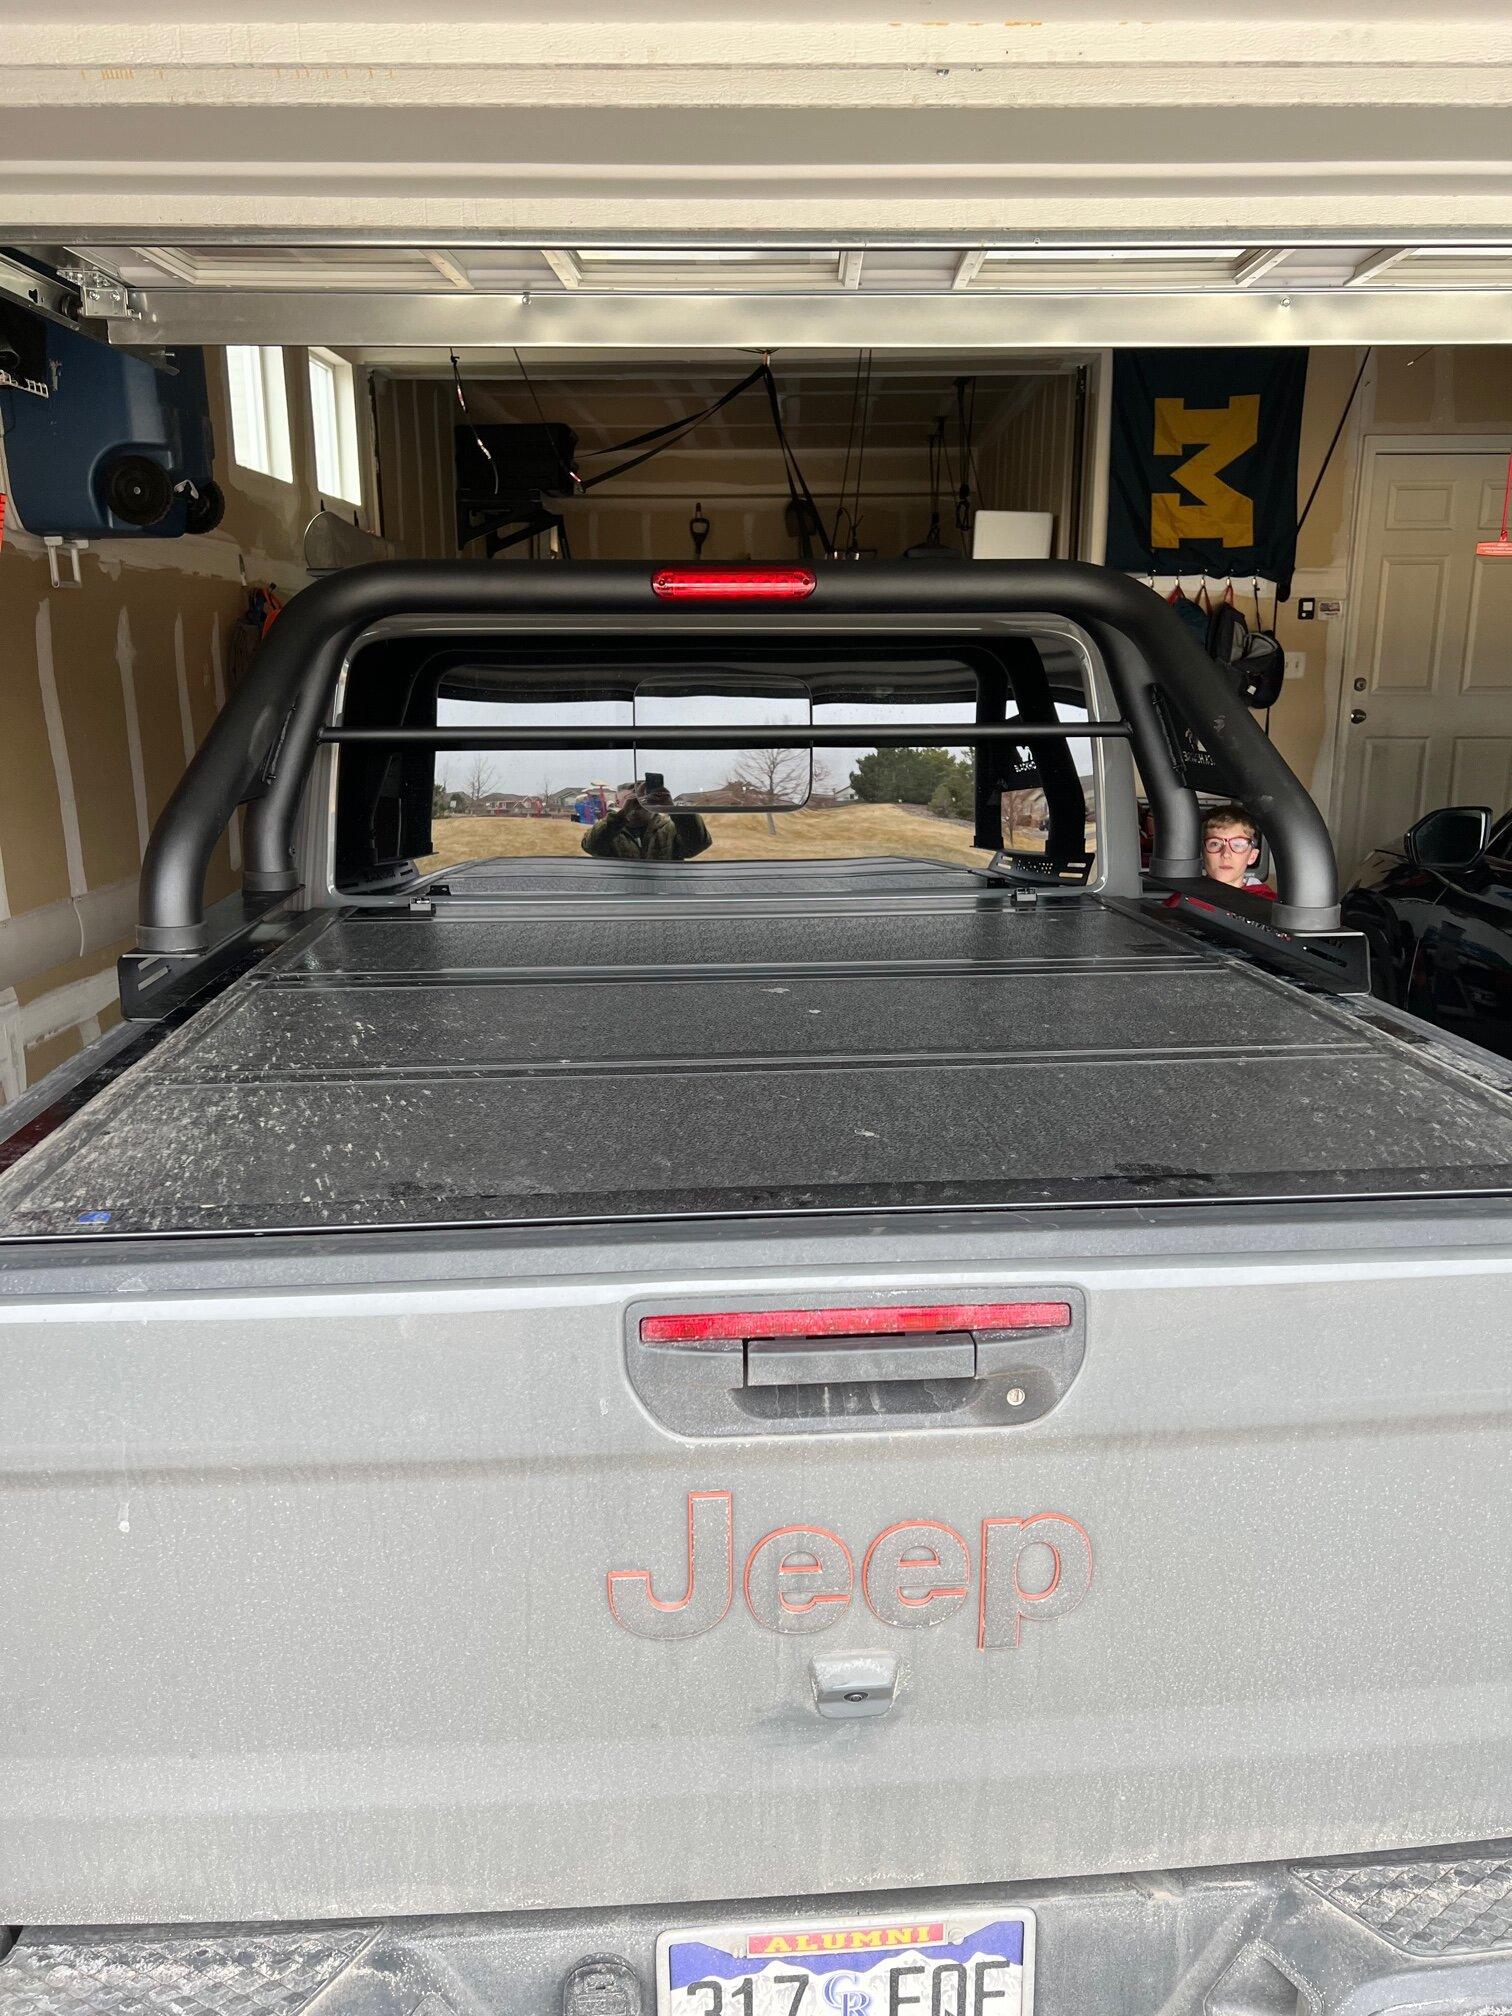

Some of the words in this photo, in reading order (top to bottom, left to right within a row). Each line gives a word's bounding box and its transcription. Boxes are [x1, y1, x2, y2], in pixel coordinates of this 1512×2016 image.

[1151, 394, 1260, 549] M
[607, 1489, 1094, 1651] Jeep
[764, 1926, 931, 1953] ALUMNI
